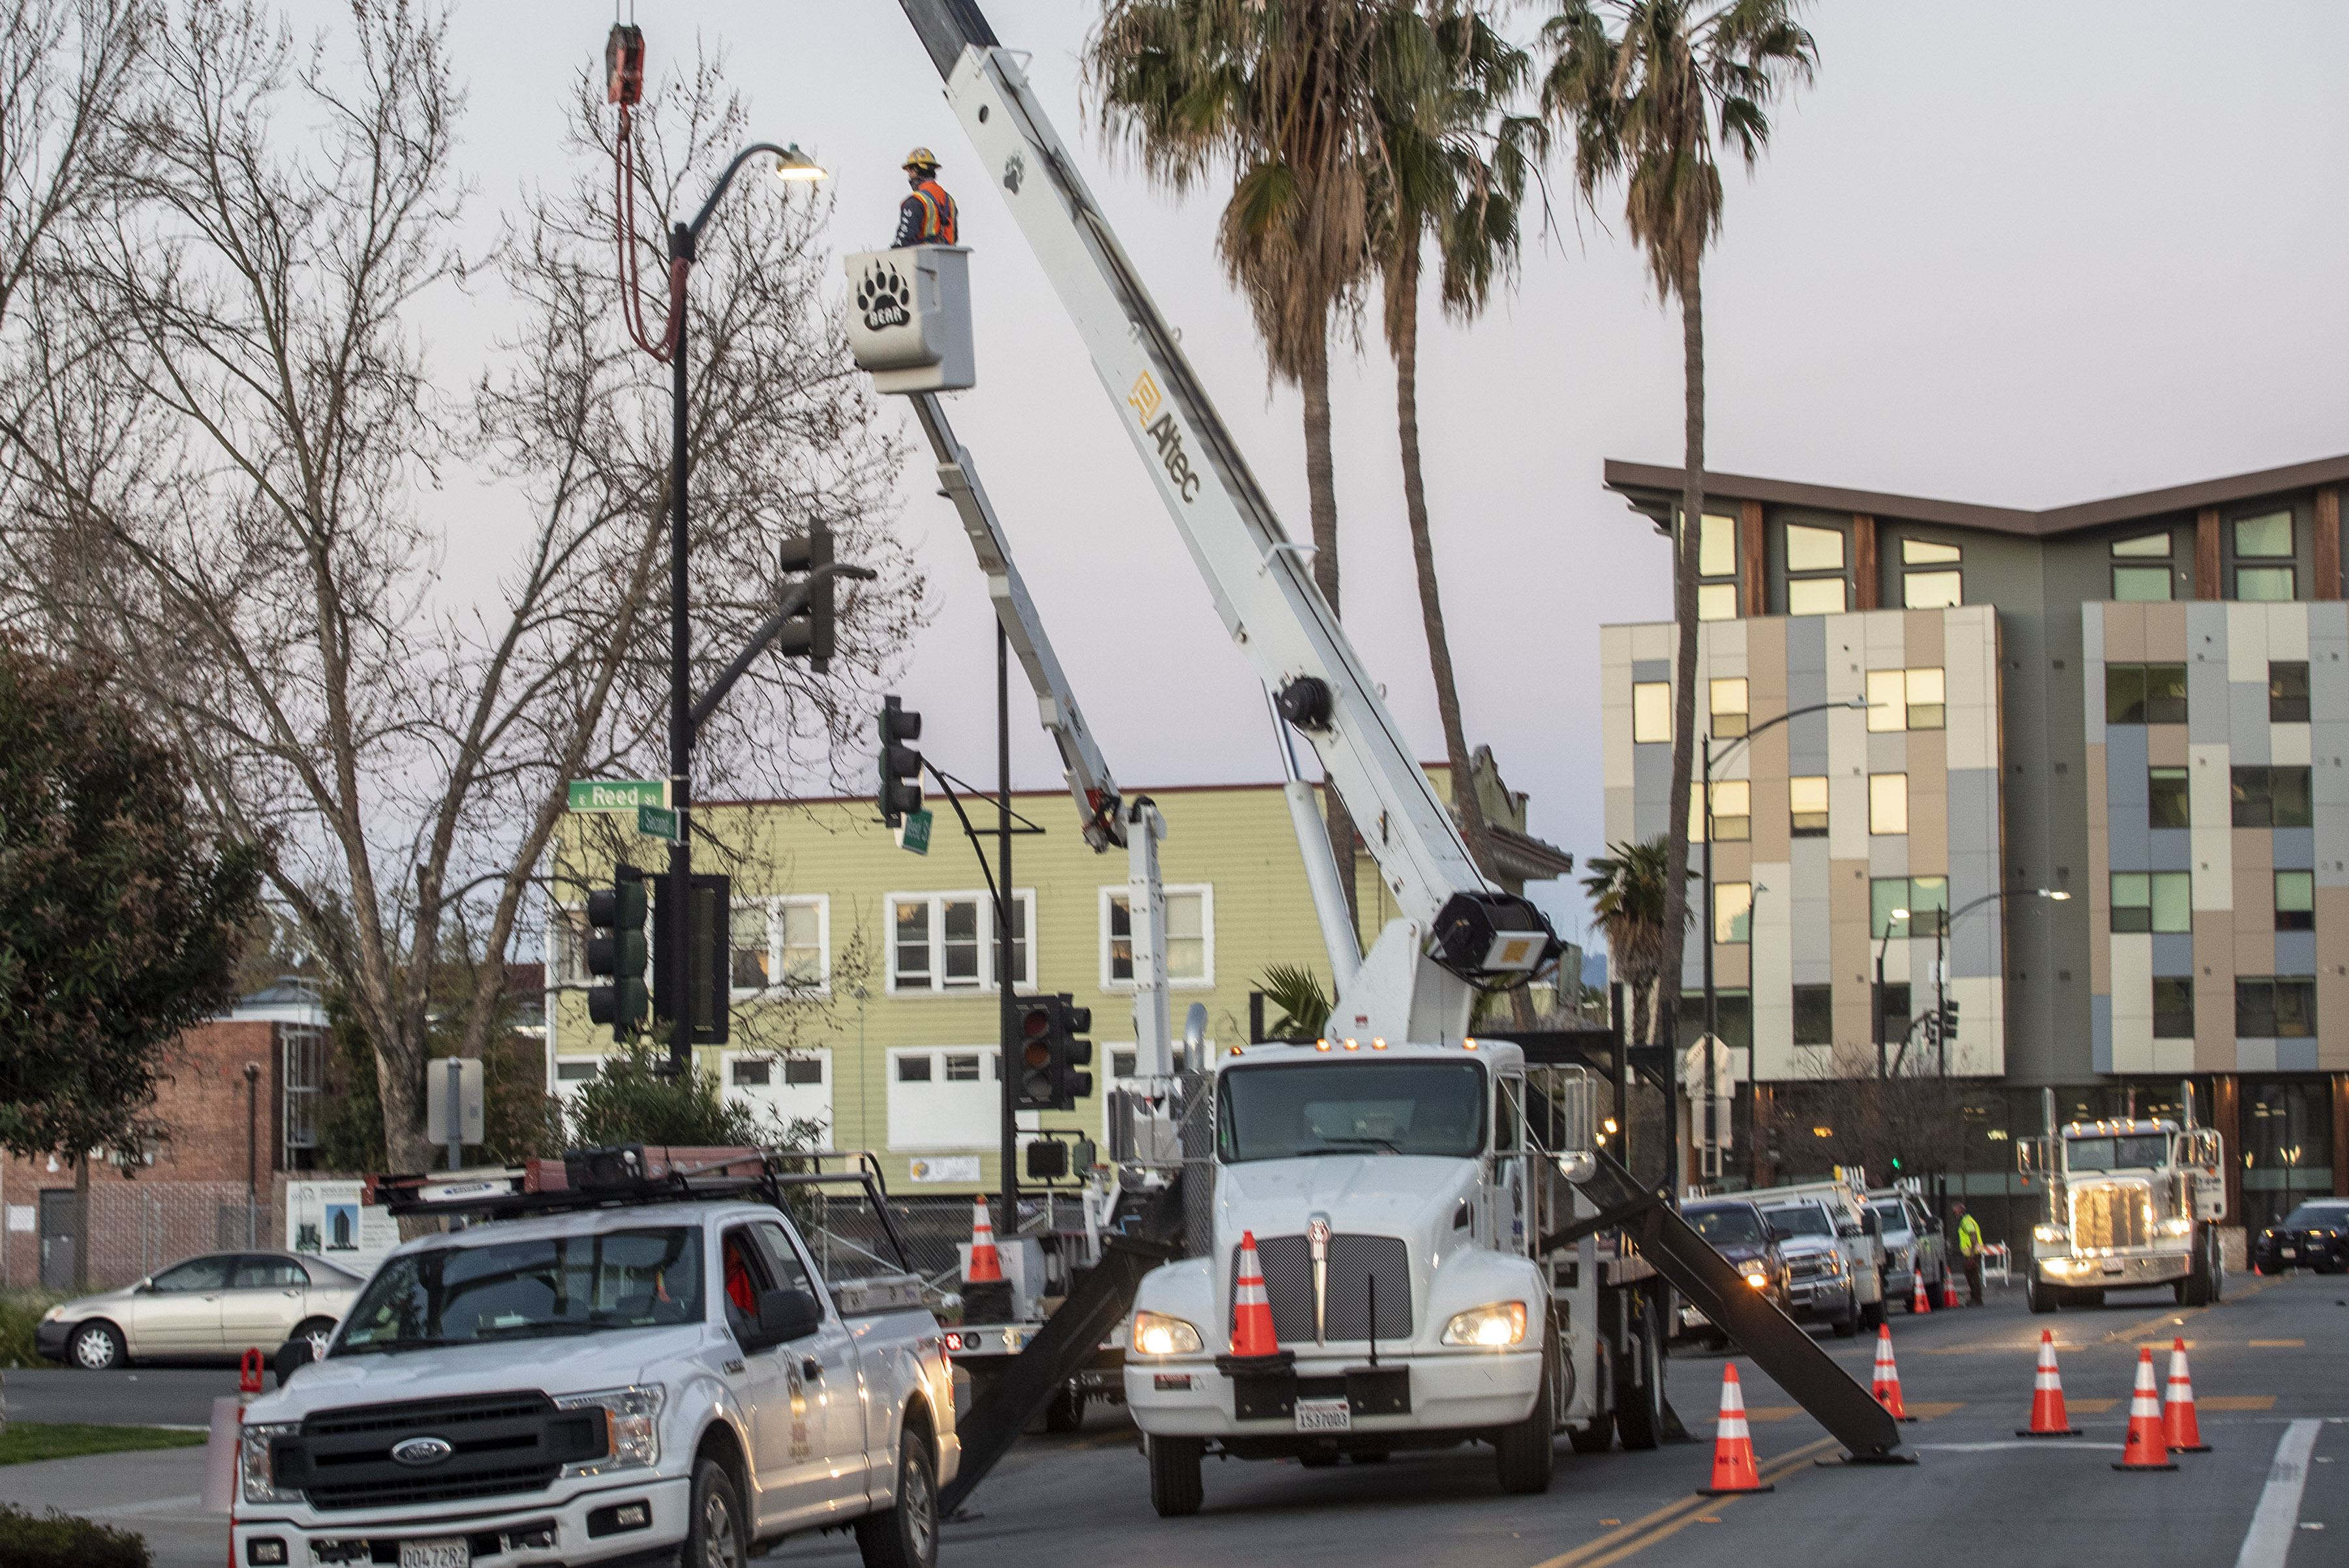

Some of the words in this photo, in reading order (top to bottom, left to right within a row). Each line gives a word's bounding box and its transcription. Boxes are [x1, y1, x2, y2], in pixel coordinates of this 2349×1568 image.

[868, 305, 903, 326] BEAR
[1145, 410, 1201, 504] Altec
[592, 785, 639, 807] Reed
[643, 793, 658, 806] St
